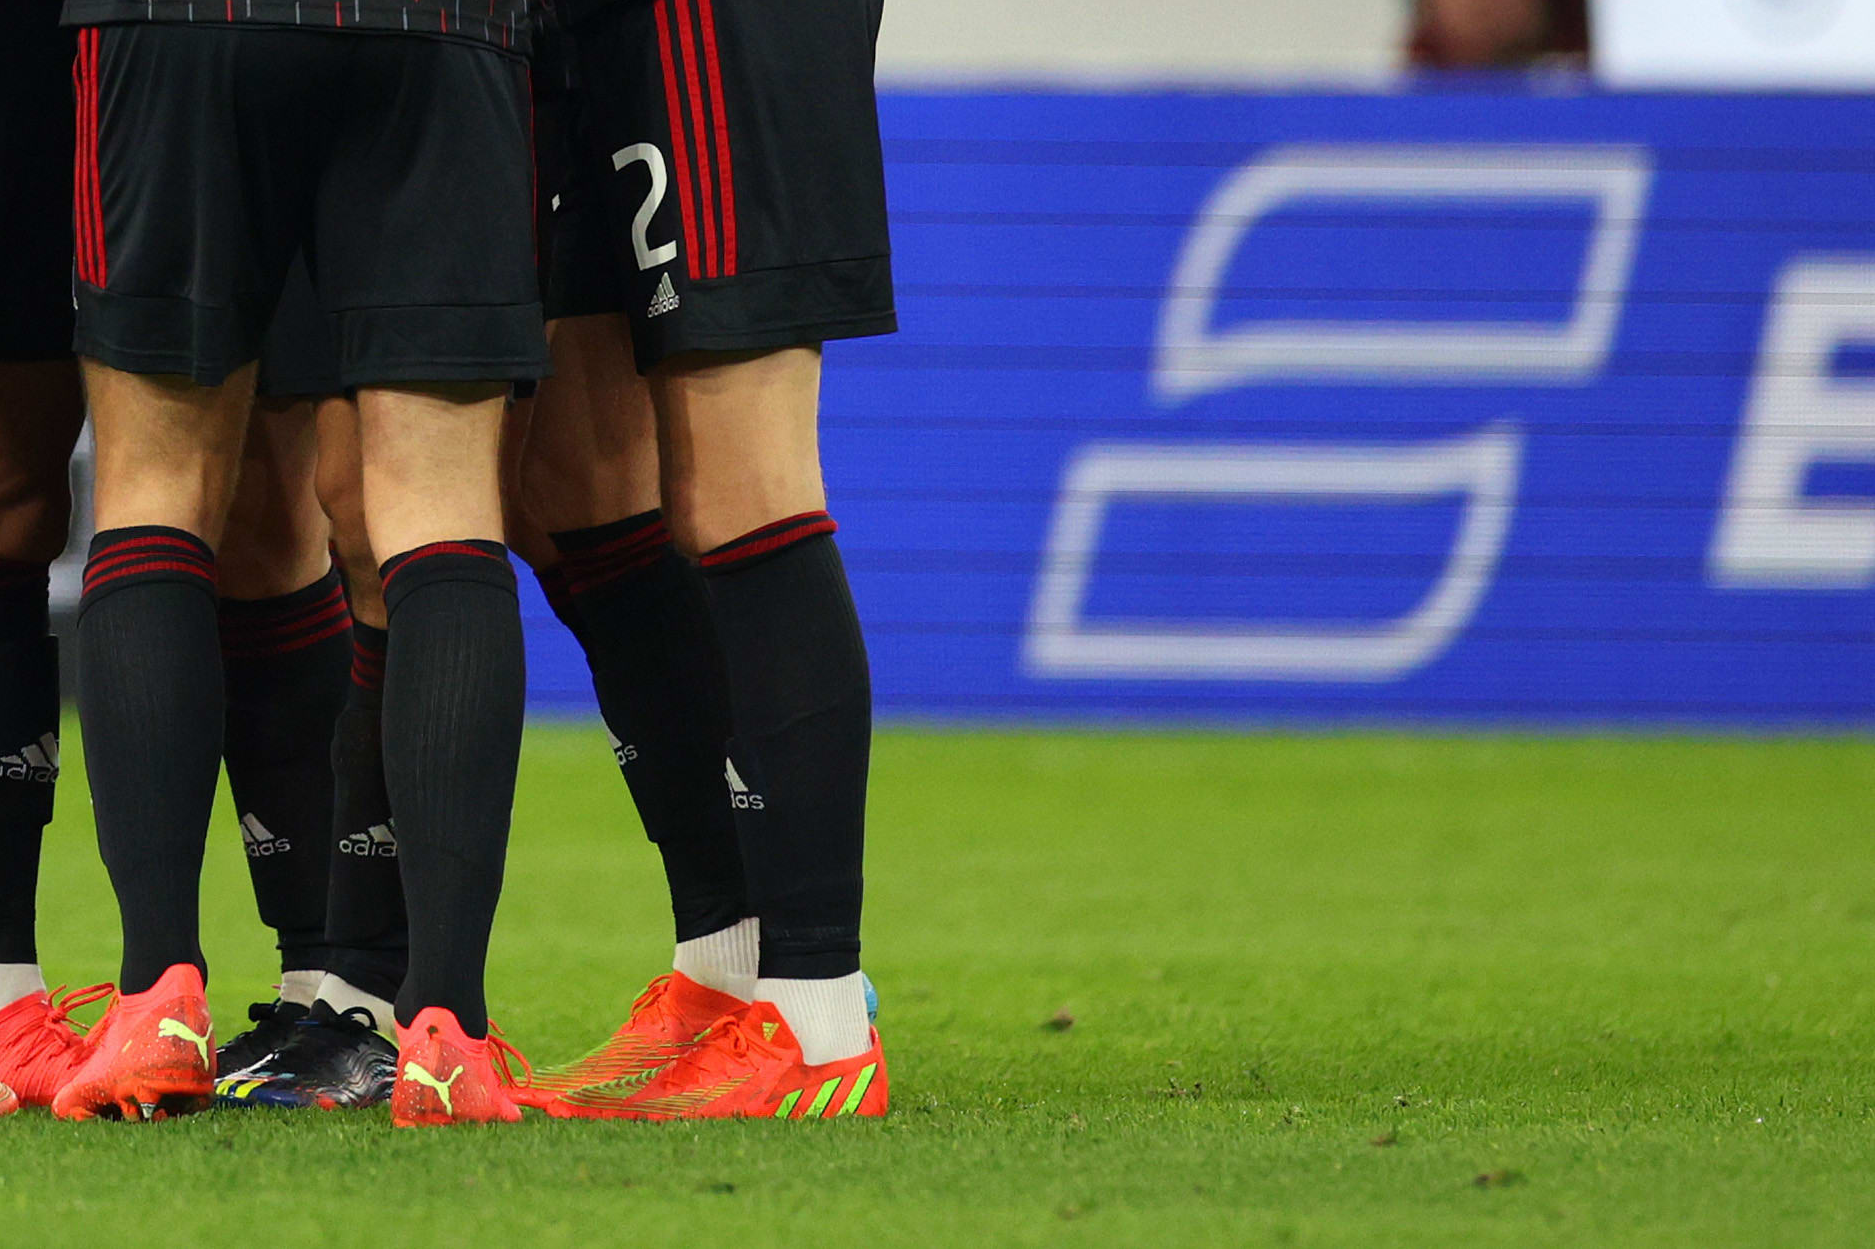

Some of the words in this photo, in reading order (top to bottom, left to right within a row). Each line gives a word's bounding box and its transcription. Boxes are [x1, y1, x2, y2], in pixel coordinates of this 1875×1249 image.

[611, 142, 678, 271] 2
[647, 294, 681, 319] adidas
[338, 838, 398, 857] adid
